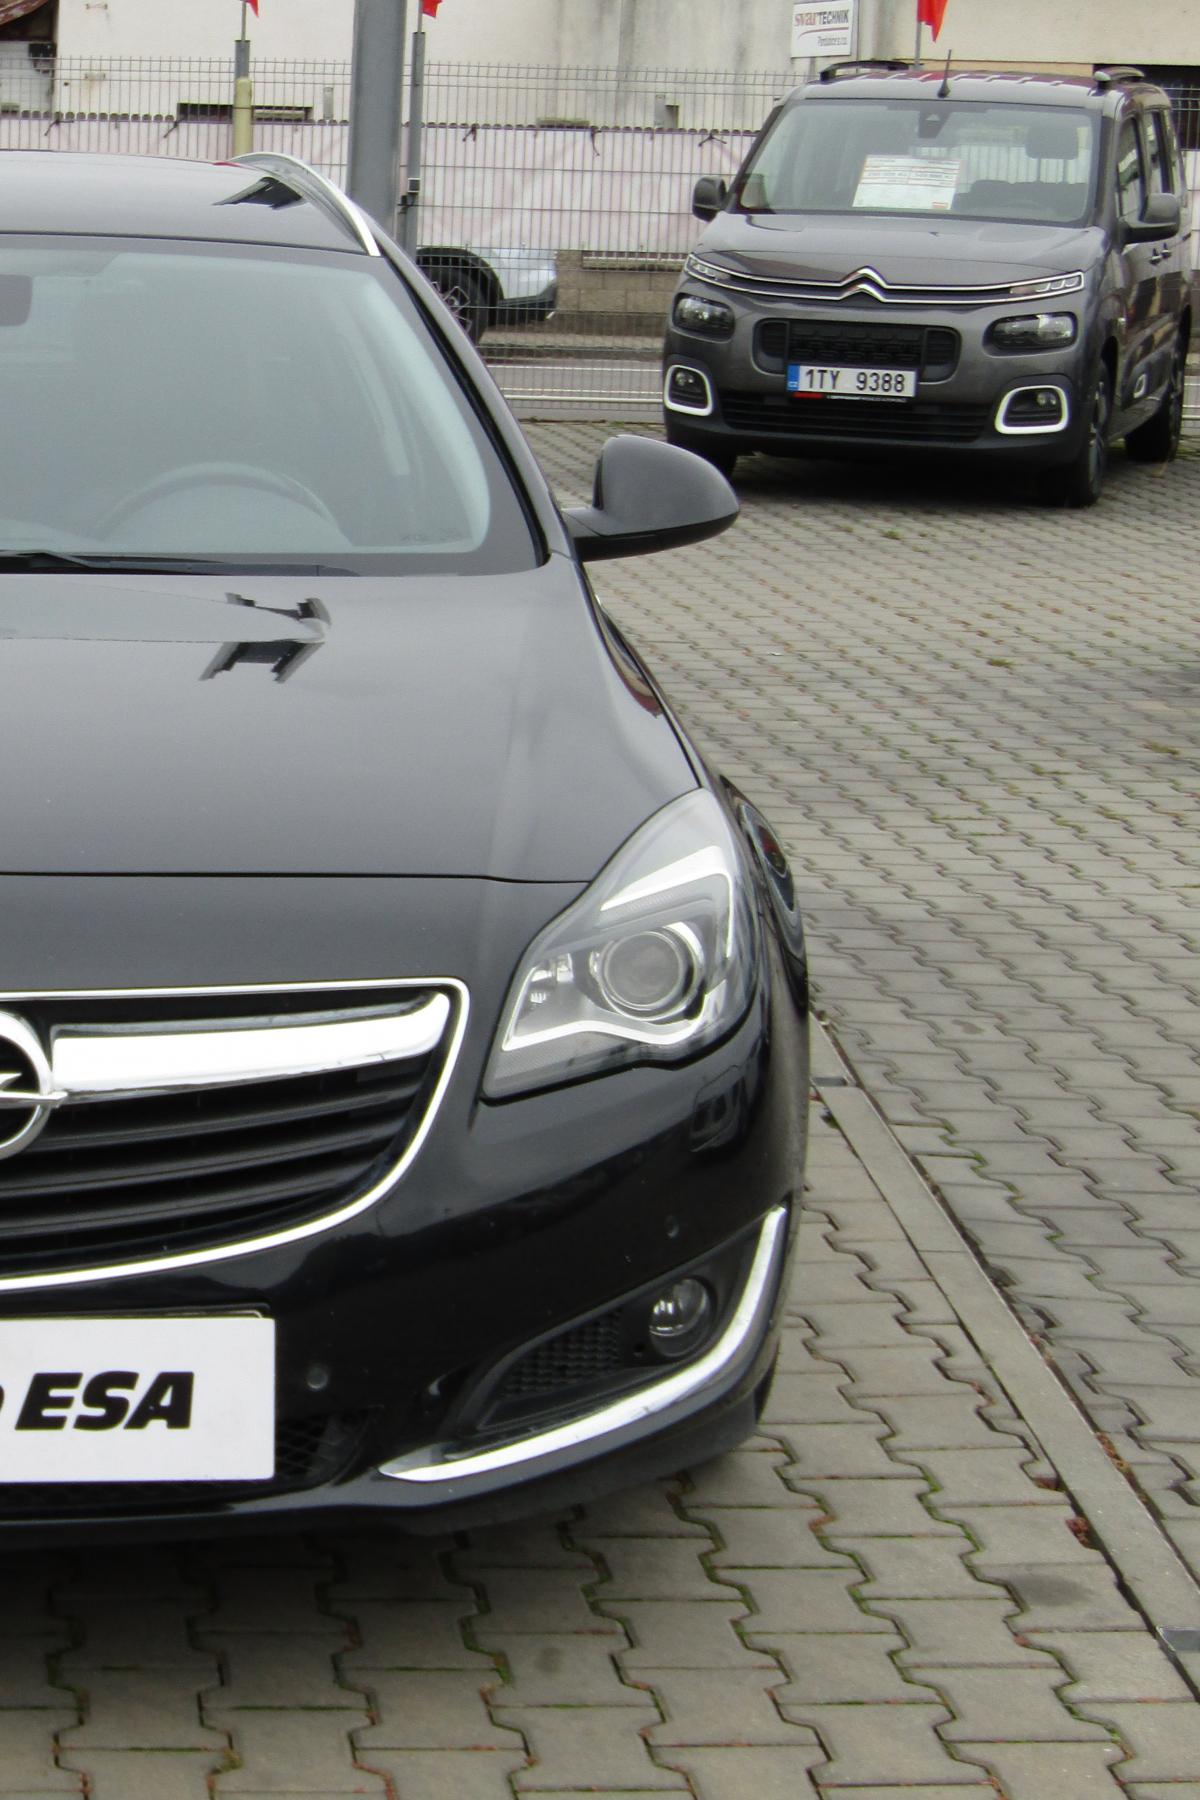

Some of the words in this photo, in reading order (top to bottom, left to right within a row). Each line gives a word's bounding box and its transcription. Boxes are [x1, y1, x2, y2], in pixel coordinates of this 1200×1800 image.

[806, 369, 840, 389] 1TY
[856, 372, 905, 392] 9388
[14, 1371, 195, 1430] ESA
